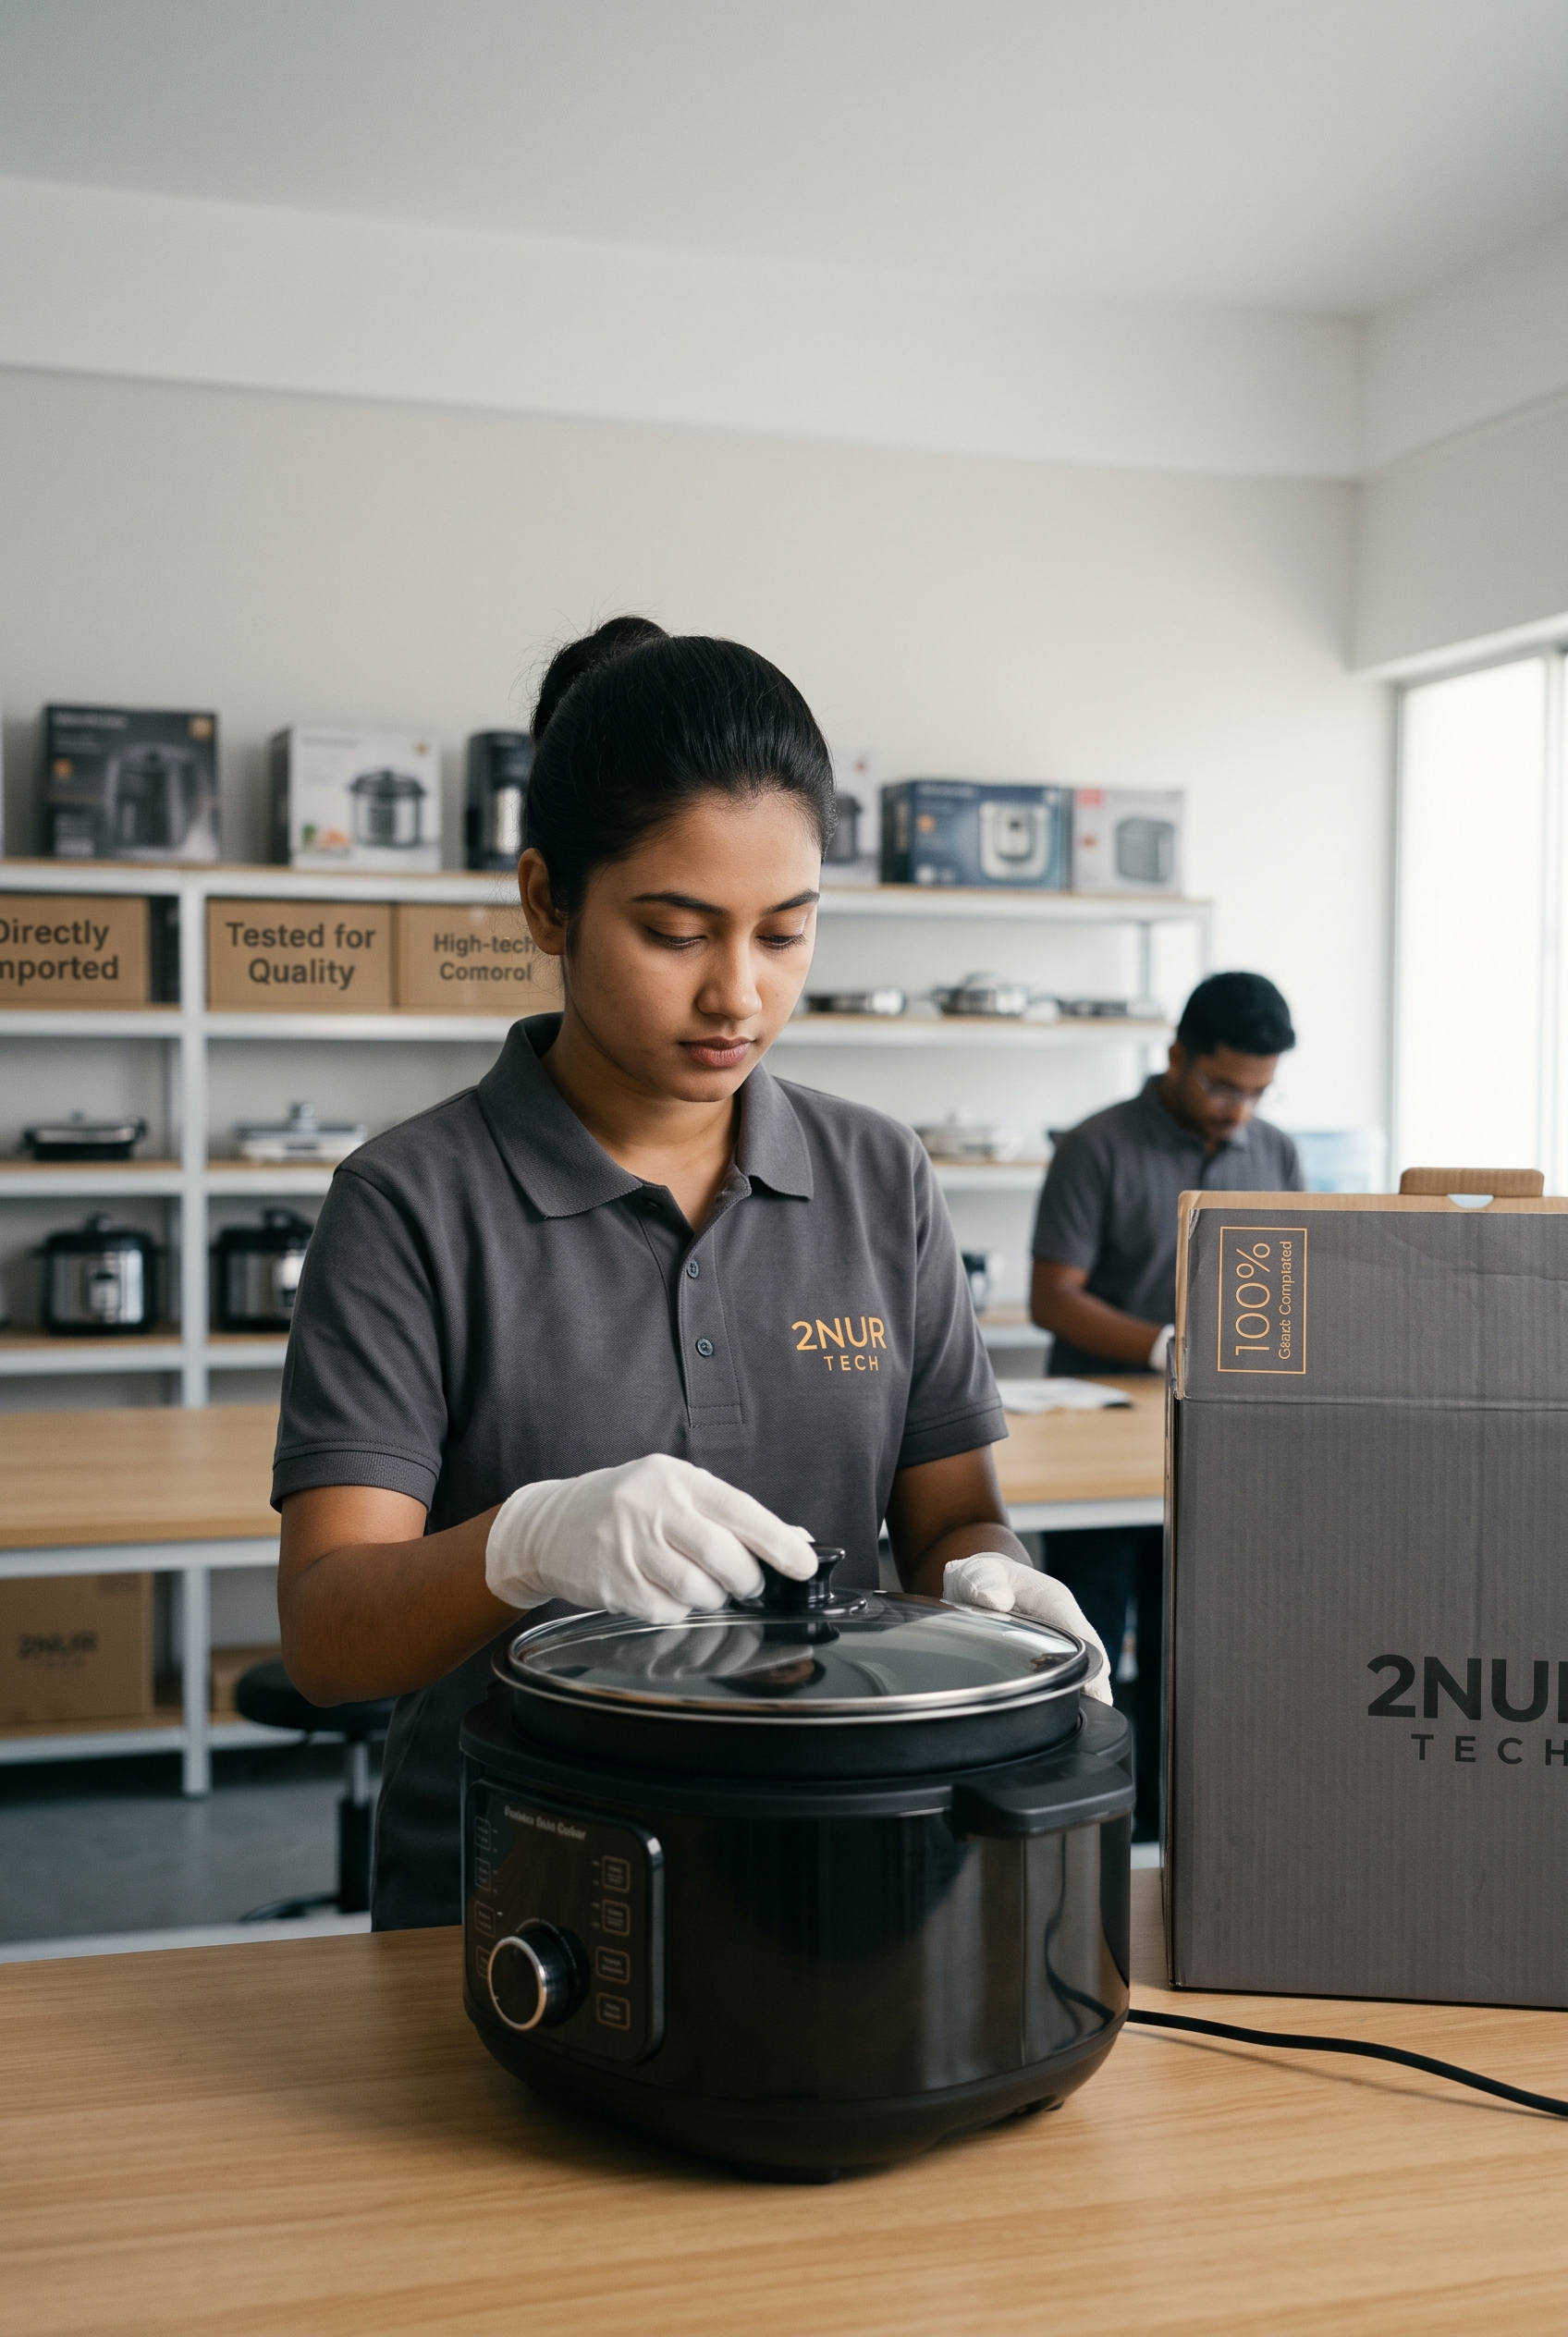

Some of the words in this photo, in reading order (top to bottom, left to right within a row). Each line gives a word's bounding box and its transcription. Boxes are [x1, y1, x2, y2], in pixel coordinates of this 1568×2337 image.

[226, 922, 325, 948] Tested
[335, 923, 376, 948] for
[434, 933, 536, 957] High-tech
[249, 958, 355, 991] Quality
[1234, 1242, 1271, 1357] 100%
[791, 1316, 888, 1351] 2NUR
[823, 1354, 879, 1371] TECH
[1366, 1654, 1568, 1724] 2NU
[1410, 1733, 1568, 1767] TECH
